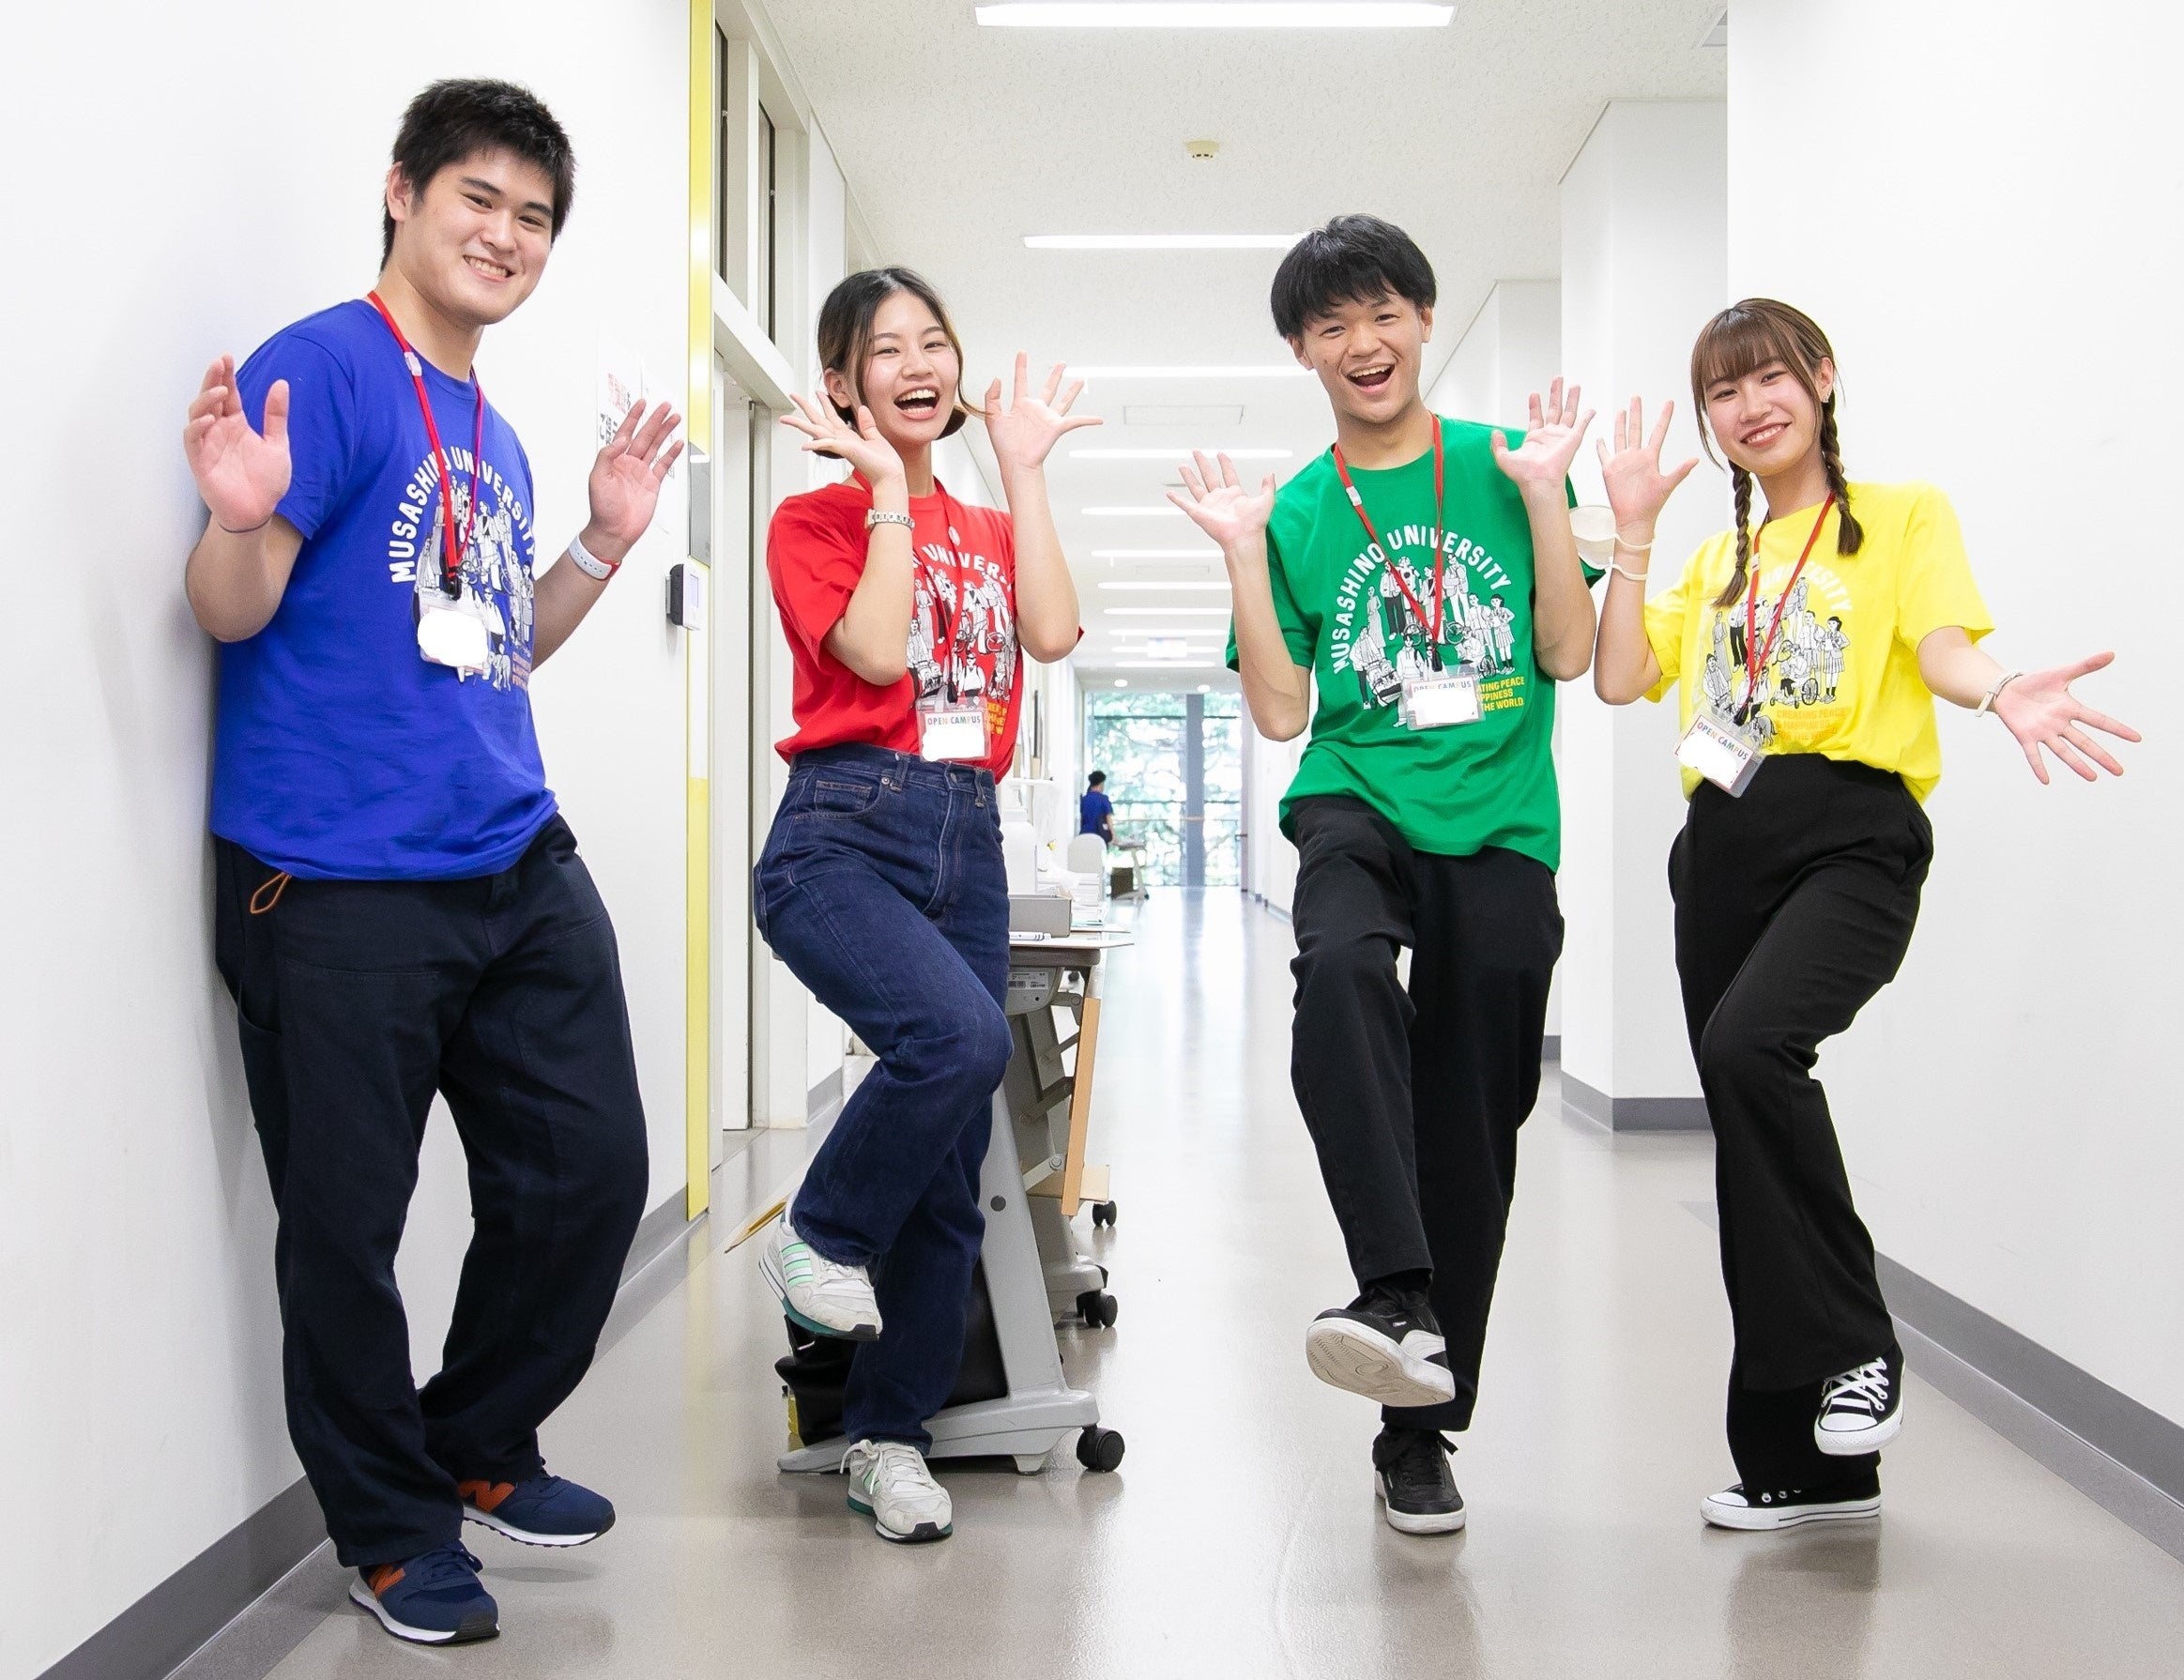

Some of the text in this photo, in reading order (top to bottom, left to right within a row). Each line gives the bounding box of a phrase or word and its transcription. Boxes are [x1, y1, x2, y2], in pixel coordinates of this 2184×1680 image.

[1331, 525, 1512, 674] MUSASHINO UNIVERSITY
[1500, 676, 1525, 689] PEACE
[1495, 697, 1523, 710] WORLD
[927, 715, 981, 725] OPEN CAMPUS
[1697, 722, 1749, 760] OPEN CAMPUS
